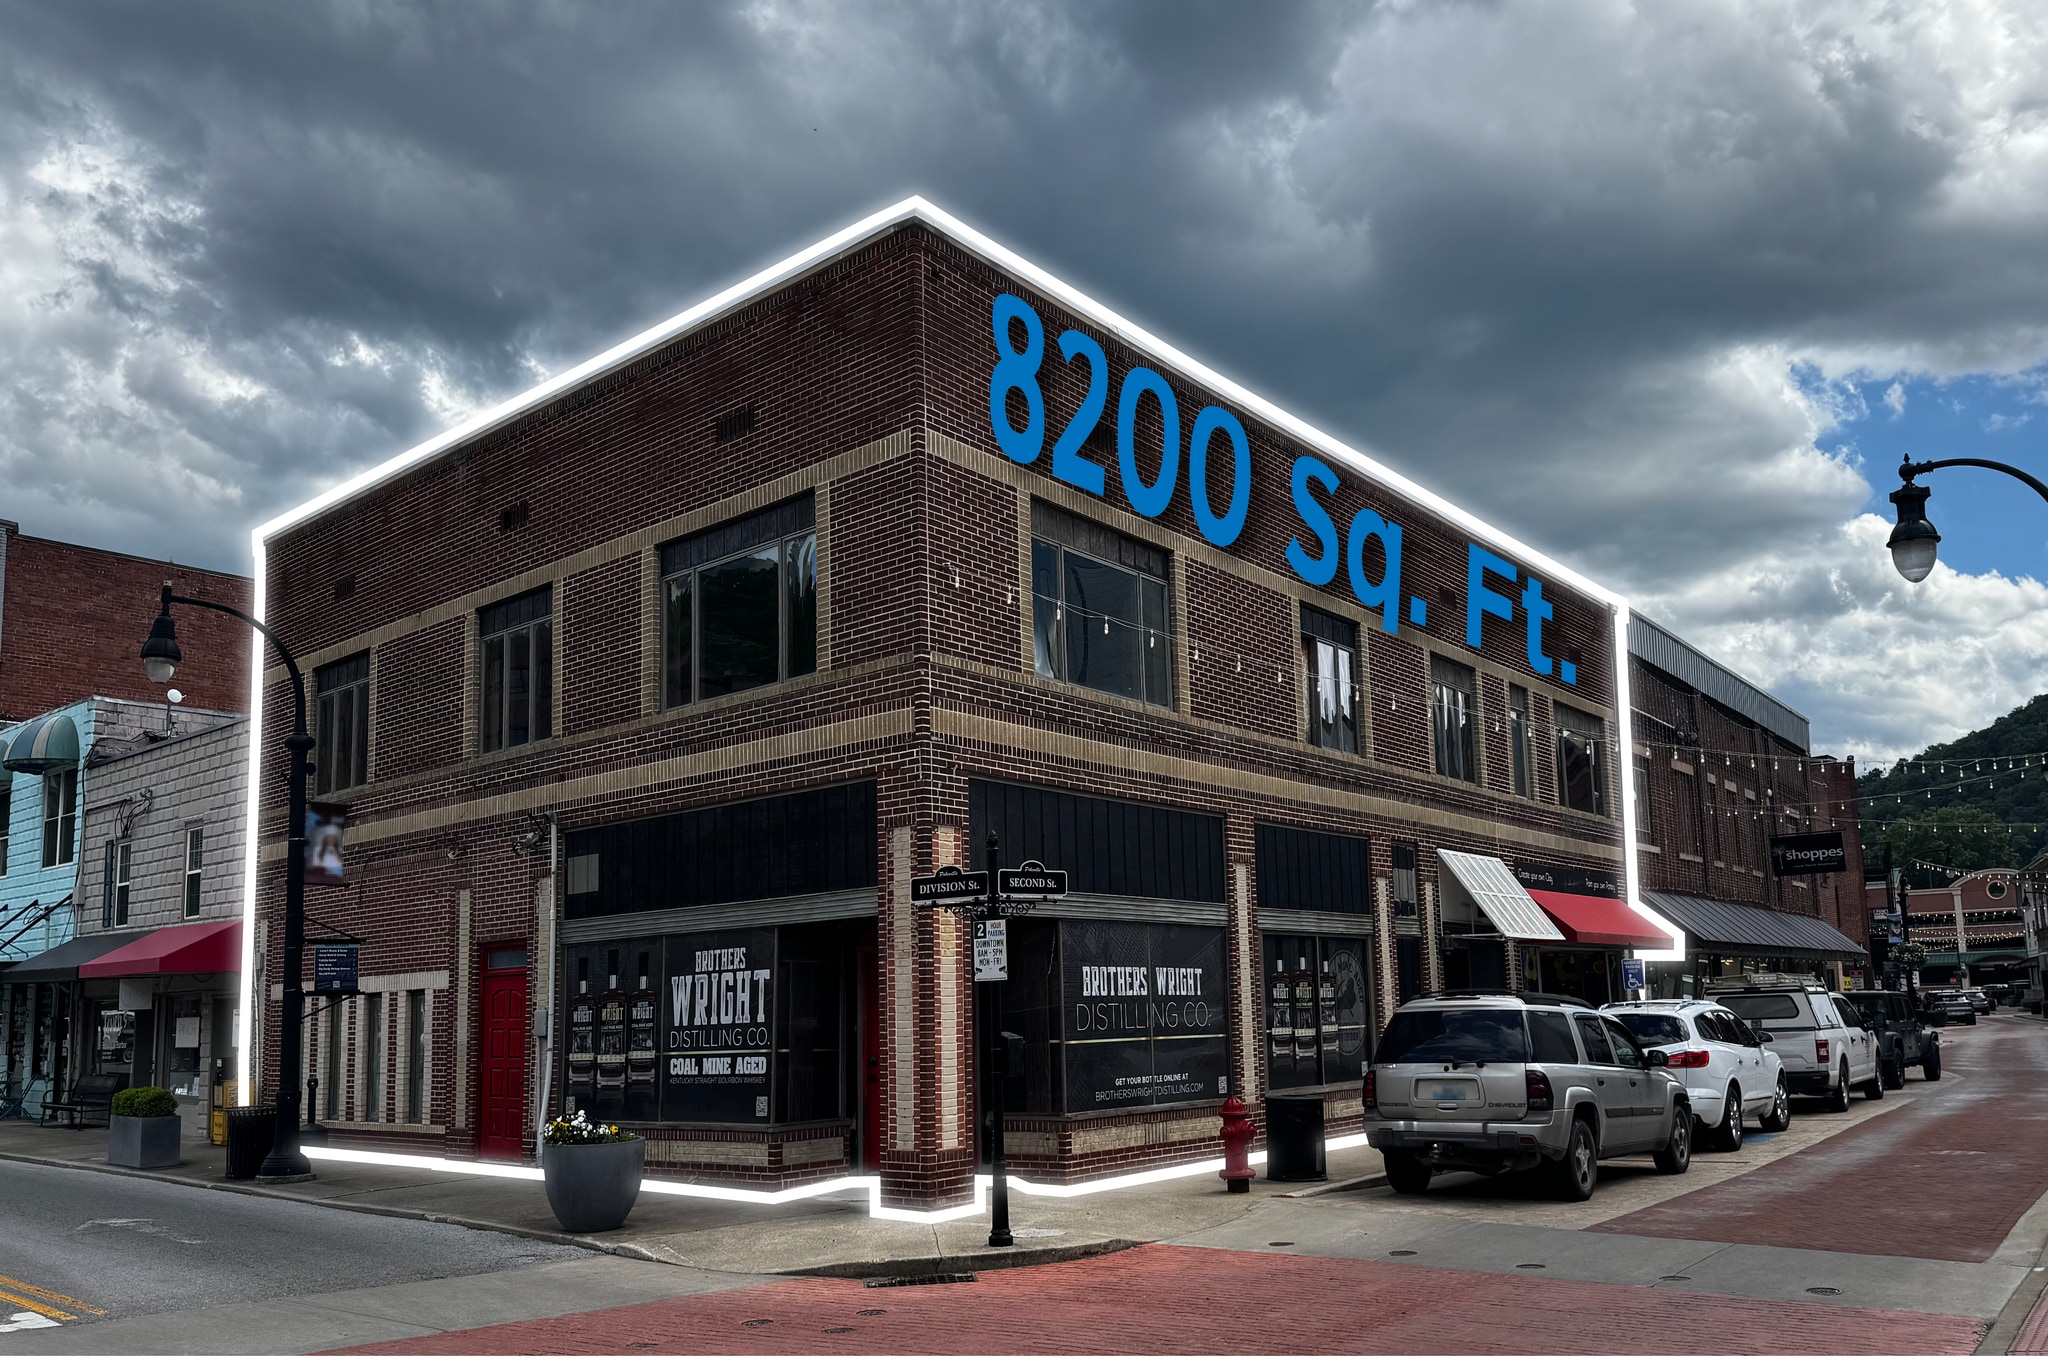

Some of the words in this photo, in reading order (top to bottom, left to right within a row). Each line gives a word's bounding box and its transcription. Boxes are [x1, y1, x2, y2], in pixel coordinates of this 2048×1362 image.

[1786, 848, 1843, 861] shoppes
[919, 880, 966, 894] DIVISION
[968, 880, 980, 890] St.
[1009, 877, 1045, 888] SECOND
[1046, 878, 1057, 888] St.
[977, 924, 984, 937] 2
[988, 929, 1005, 937] PARKING
[976, 940, 1004, 948] DOWNTOWN
[992, 948, 1002, 956] 5PM
[695, 947, 746, 972] BROTHERS
[1082, 966, 1148, 996] BROTHERS
[1156, 966, 1202, 996] WRIGHT
[672, 968, 770, 1027] WRIGHT
[1076, 1001, 1178, 1031] DISTILLING
[1184, 1001, 1211, 1027] CO.
[670, 1028, 742, 1048] DISTILLING
[746, 1027, 770, 1046] CO.
[670, 1058, 698, 1075] COAL
[702, 1057, 731, 1075] MINE
[735, 1056, 767, 1075] AGED
[670, 1077, 694, 1085] KENTUCKY
[718, 1076, 742, 1084] BOURBON
[743, 1076, 766, 1084] WHISKEY
[1115, 1078, 1126, 1086] GET
[1126, 1076, 1141, 1085] YOUR
[1164, 1074, 1181, 1083] ONLINE
